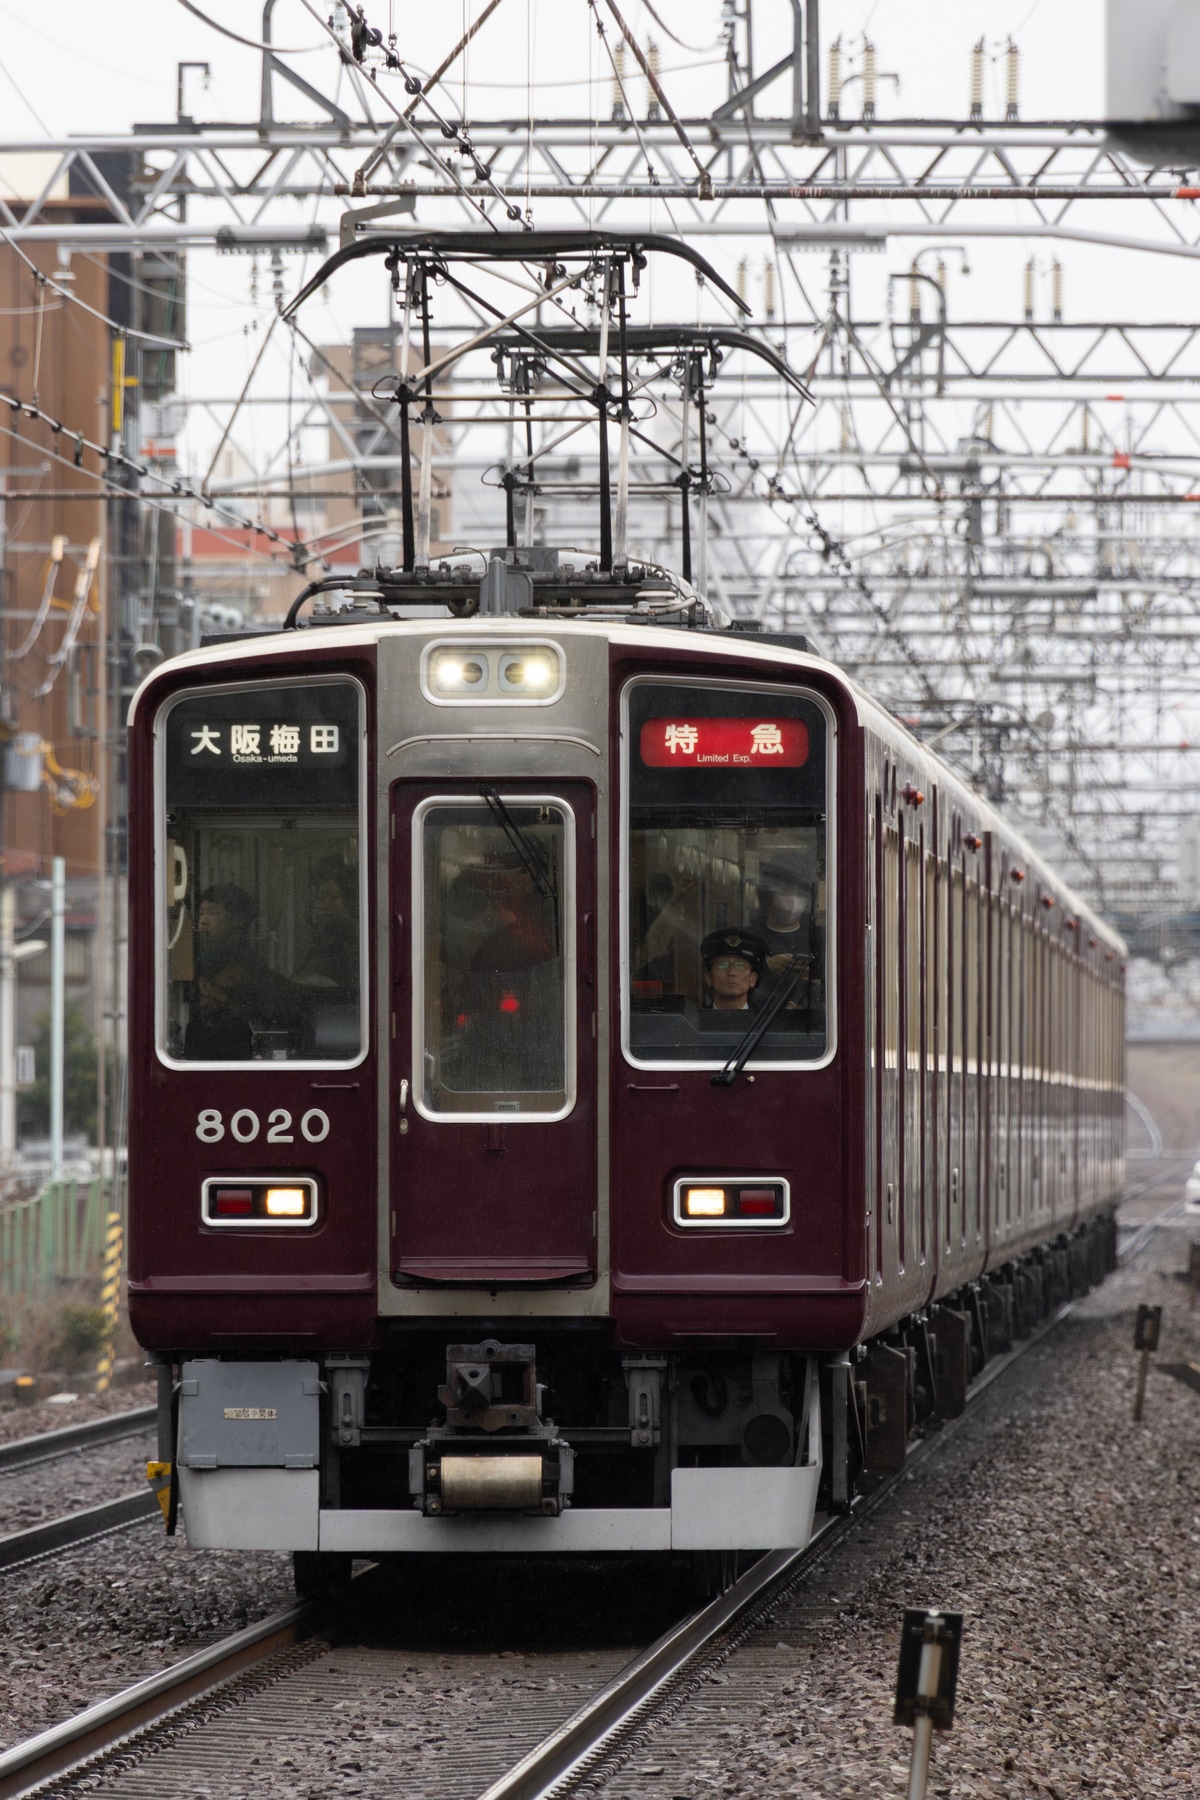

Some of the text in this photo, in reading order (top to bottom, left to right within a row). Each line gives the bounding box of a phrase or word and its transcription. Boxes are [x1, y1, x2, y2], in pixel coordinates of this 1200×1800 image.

[190, 724, 339, 755] 大阪梅田
[664, 723, 784, 754] 特急
[232, 754, 298, 763] Osaka-umeda
[697, 753, 752, 764] Limited Exp.
[195, 1108, 331, 1144] 8020
